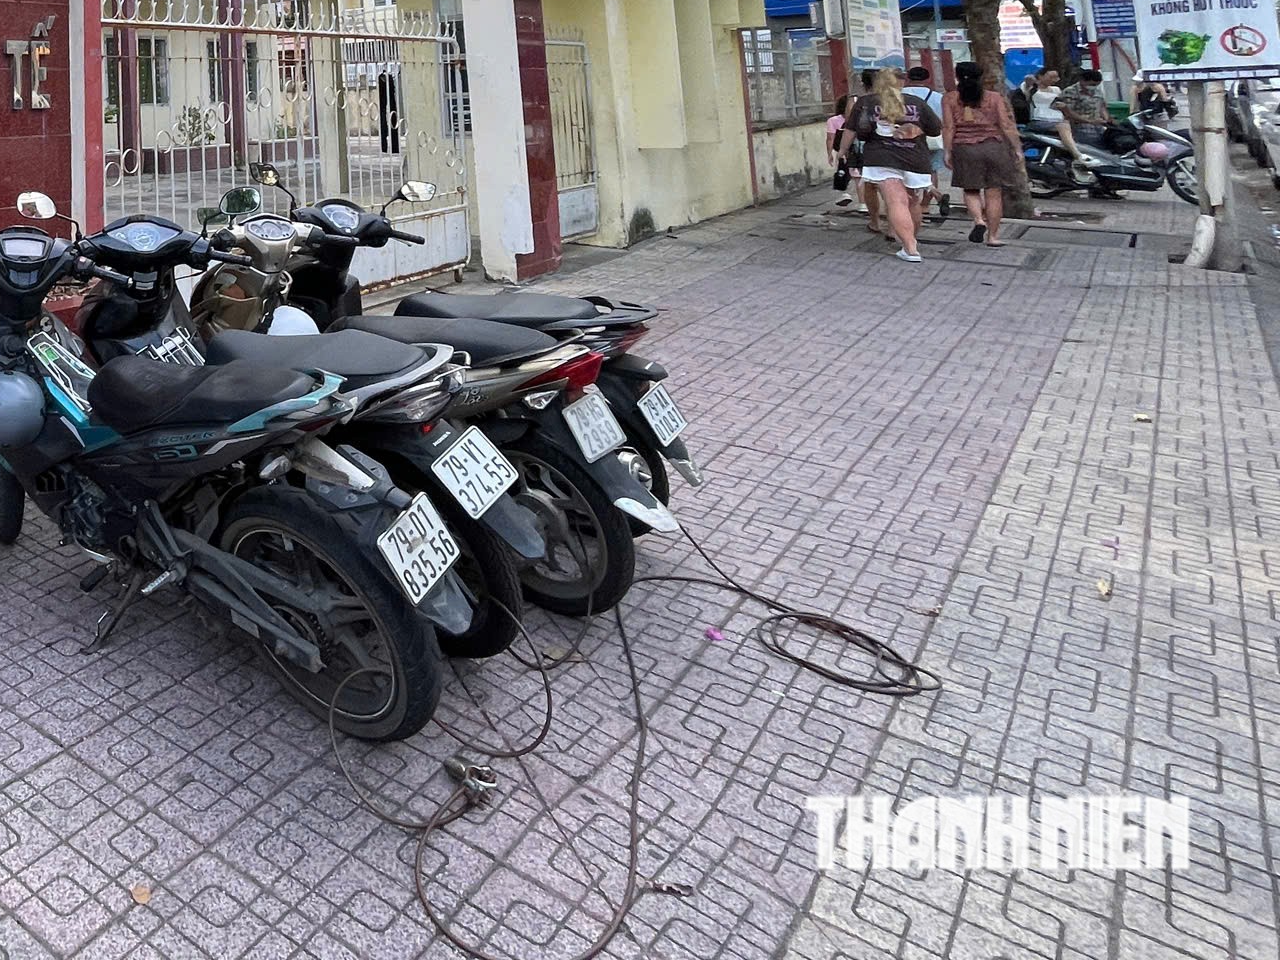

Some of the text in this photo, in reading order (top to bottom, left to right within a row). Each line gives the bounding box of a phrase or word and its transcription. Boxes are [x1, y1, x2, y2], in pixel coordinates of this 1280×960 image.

[1151, 0, 1189, 16] KHÔNG
[6, 14, 56, 110] TẾ
[442, 439, 487, 484] 79-V1
[459, 456, 511, 511] 374.55
[388, 504, 434, 563] 79-D1
[403, 530, 454, 597] 835.56
